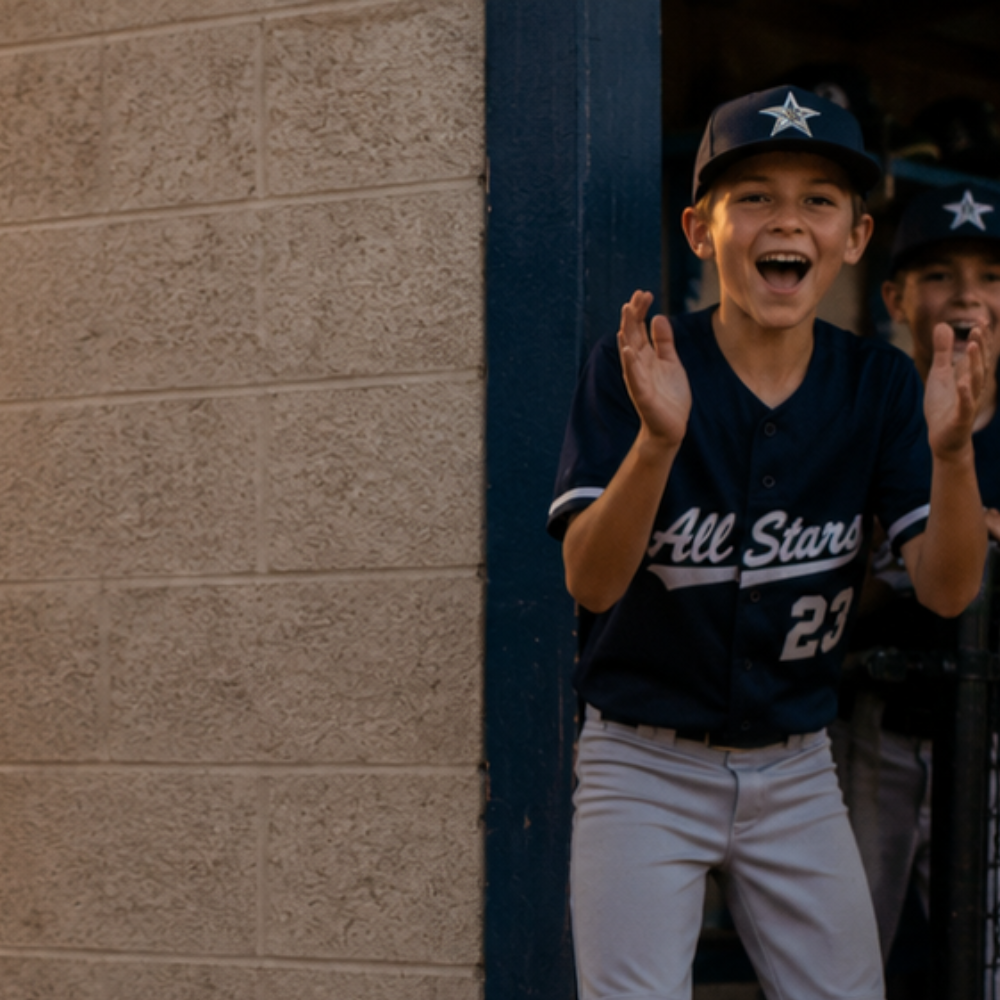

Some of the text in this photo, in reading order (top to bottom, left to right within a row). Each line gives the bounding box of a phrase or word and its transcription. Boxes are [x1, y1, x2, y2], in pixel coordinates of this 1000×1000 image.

[649, 507, 735, 563] All
[743, 510, 863, 567] Stars
[779, 587, 854, 661] 23
